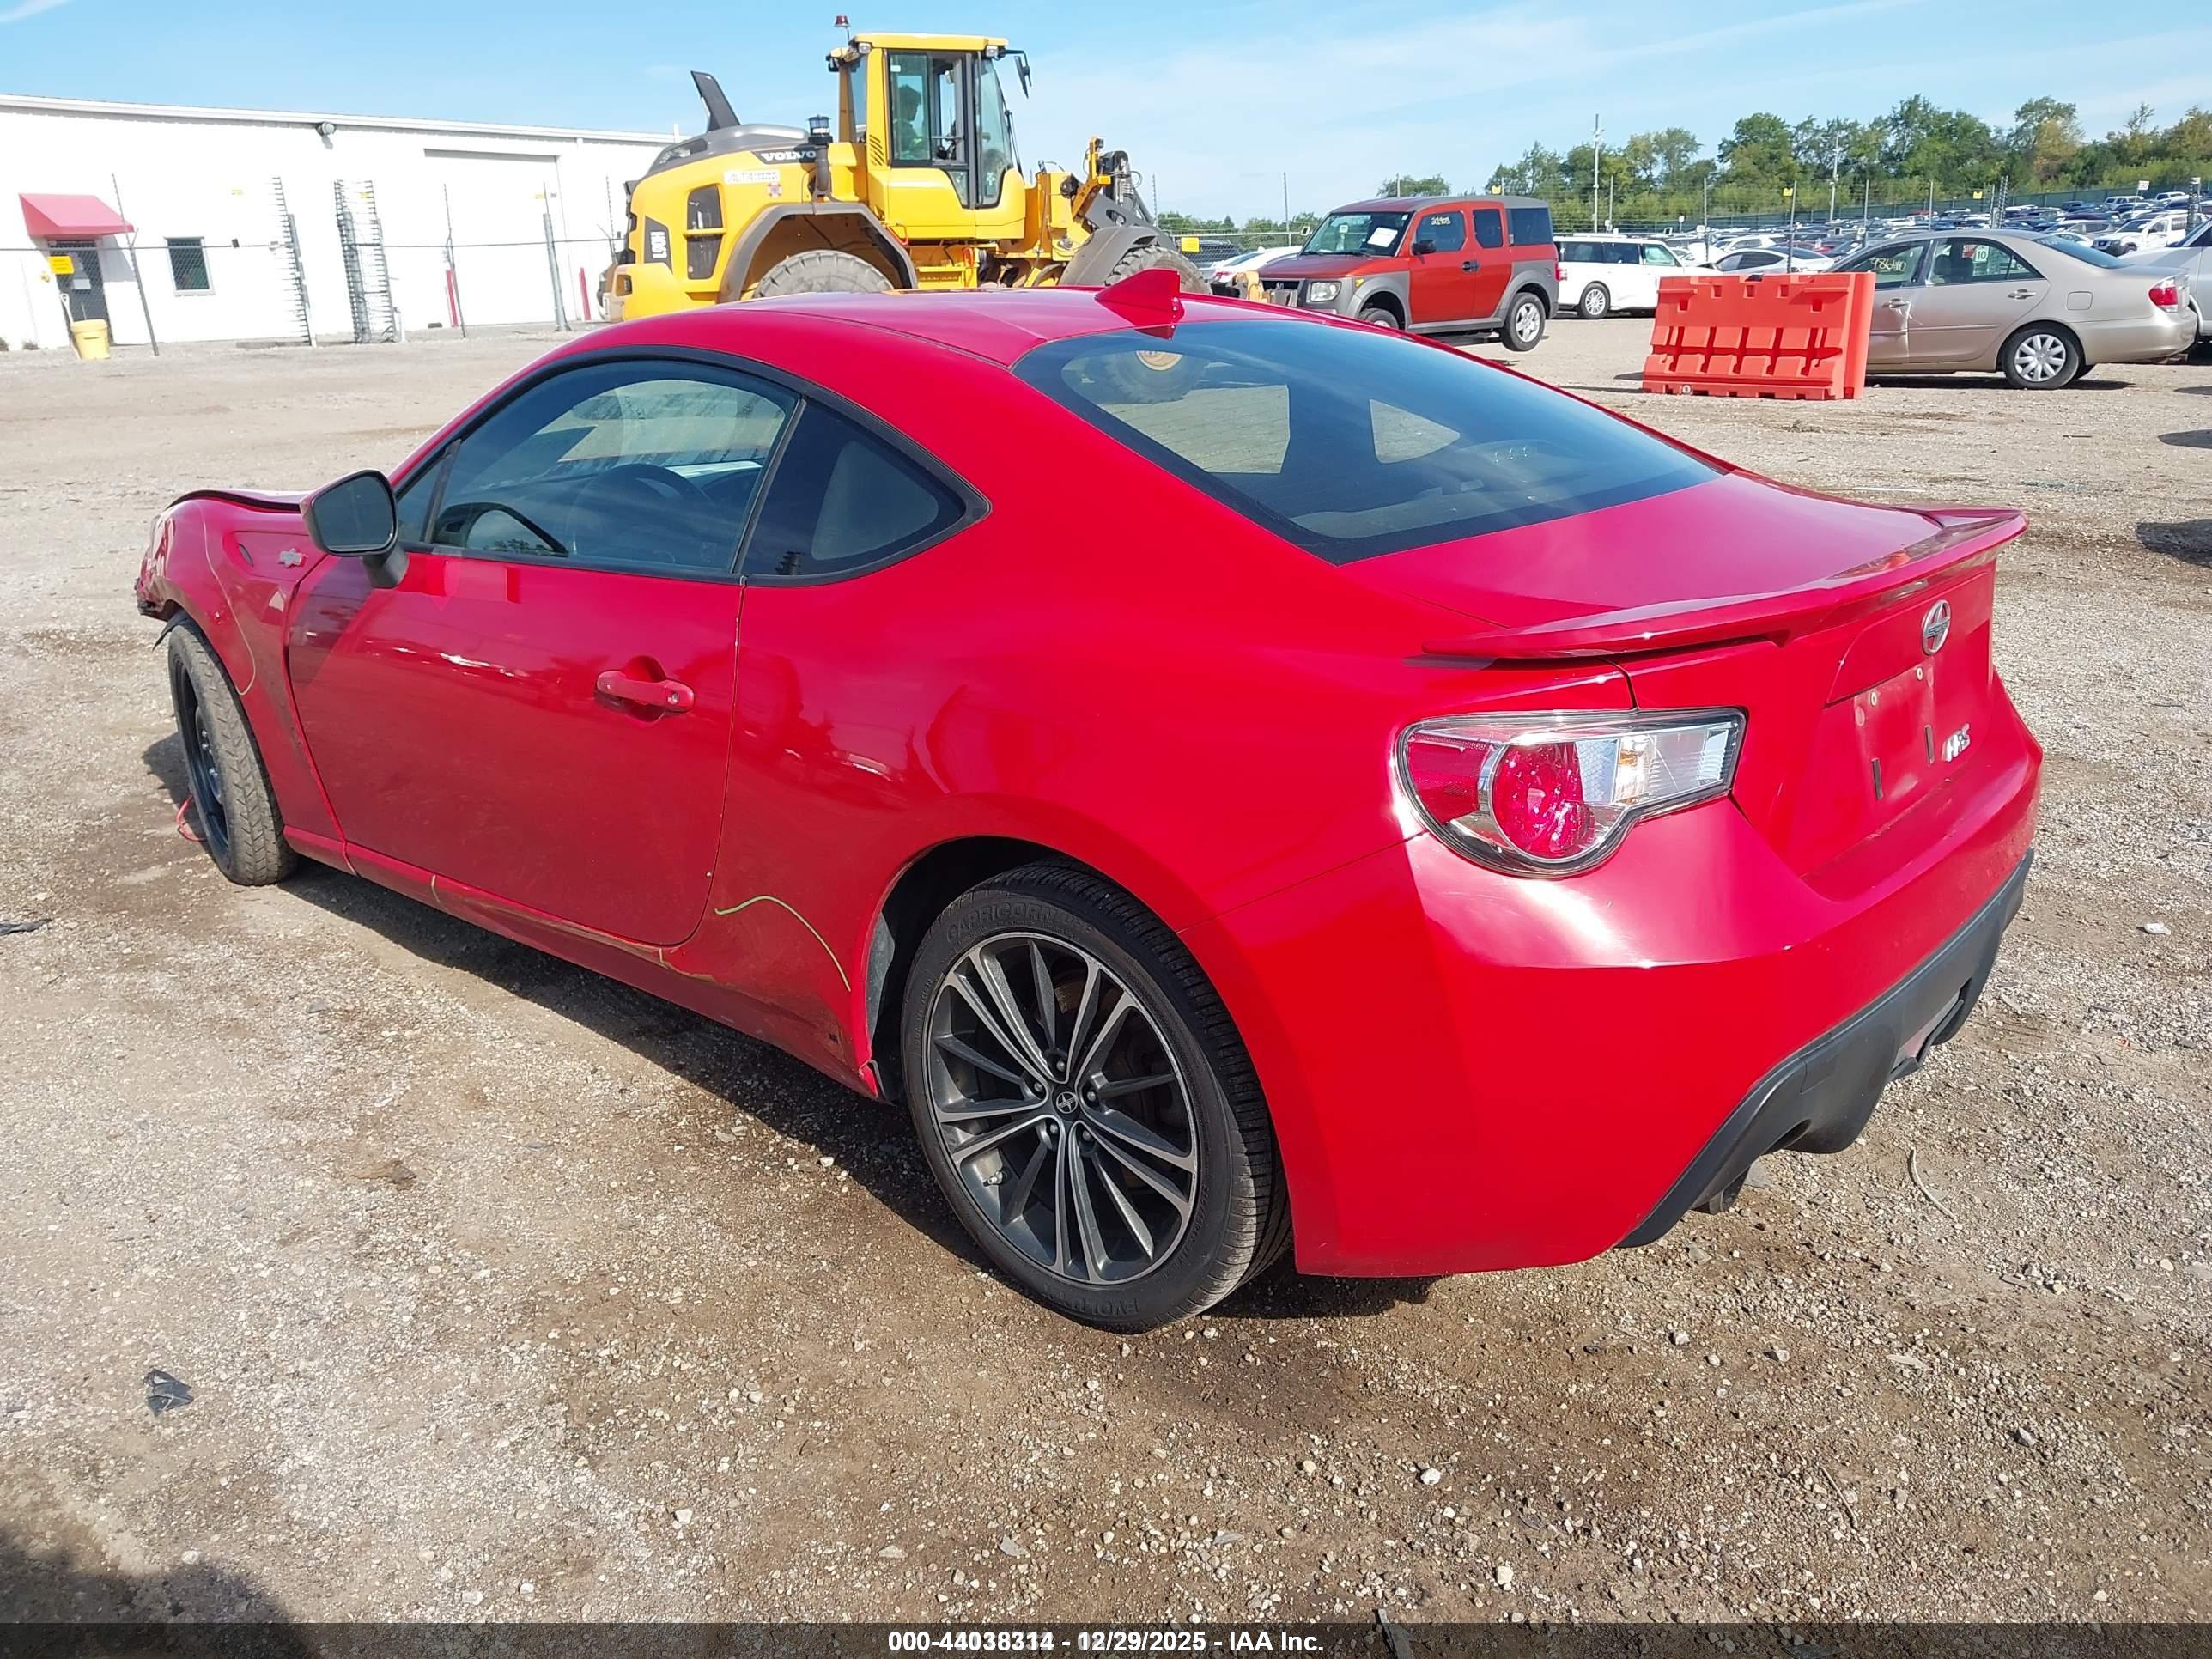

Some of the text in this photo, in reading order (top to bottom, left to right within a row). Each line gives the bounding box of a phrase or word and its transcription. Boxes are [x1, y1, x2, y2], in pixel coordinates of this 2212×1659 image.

[760, 150, 817, 161] VOLVO
[650, 231, 668, 259] L90H
[1977, 250, 1987, 260] 10
